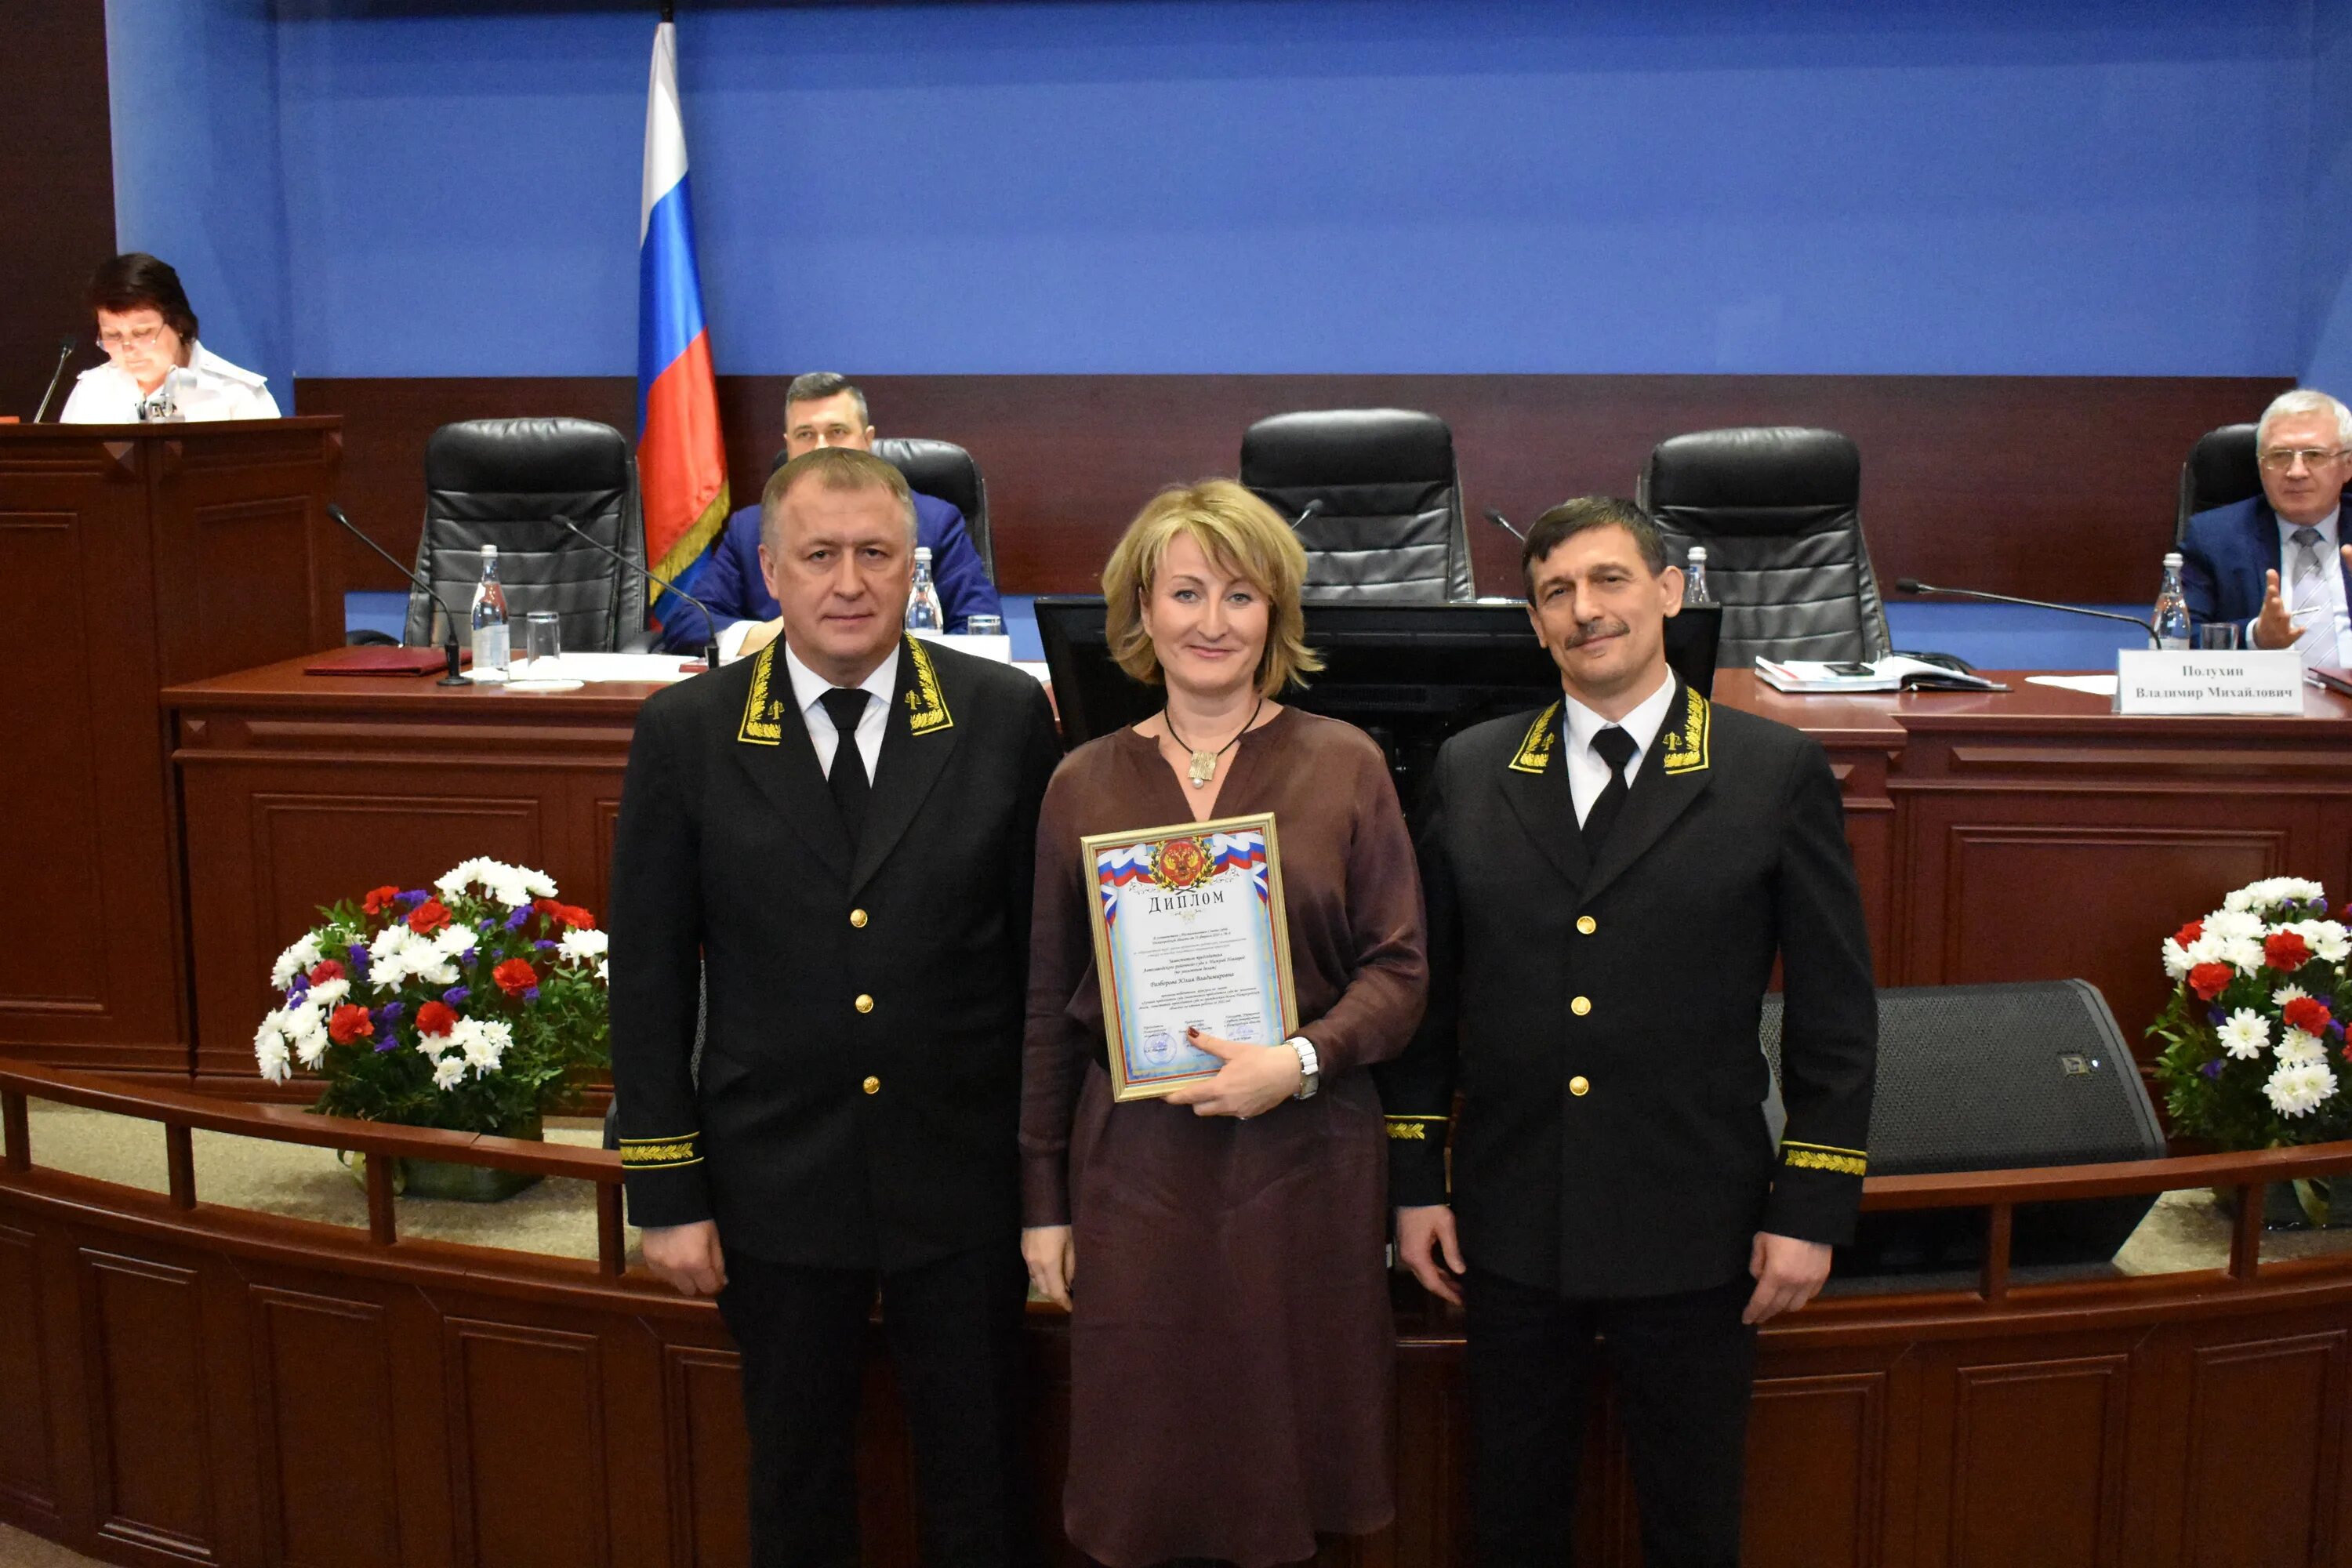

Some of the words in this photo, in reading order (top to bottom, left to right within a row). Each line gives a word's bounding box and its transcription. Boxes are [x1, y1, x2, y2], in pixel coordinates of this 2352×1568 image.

[2182, 665, 2244, 679] Полухин
[2136, 687, 2204, 700] Владимир
[2207, 686, 2292, 698] Михайлович
